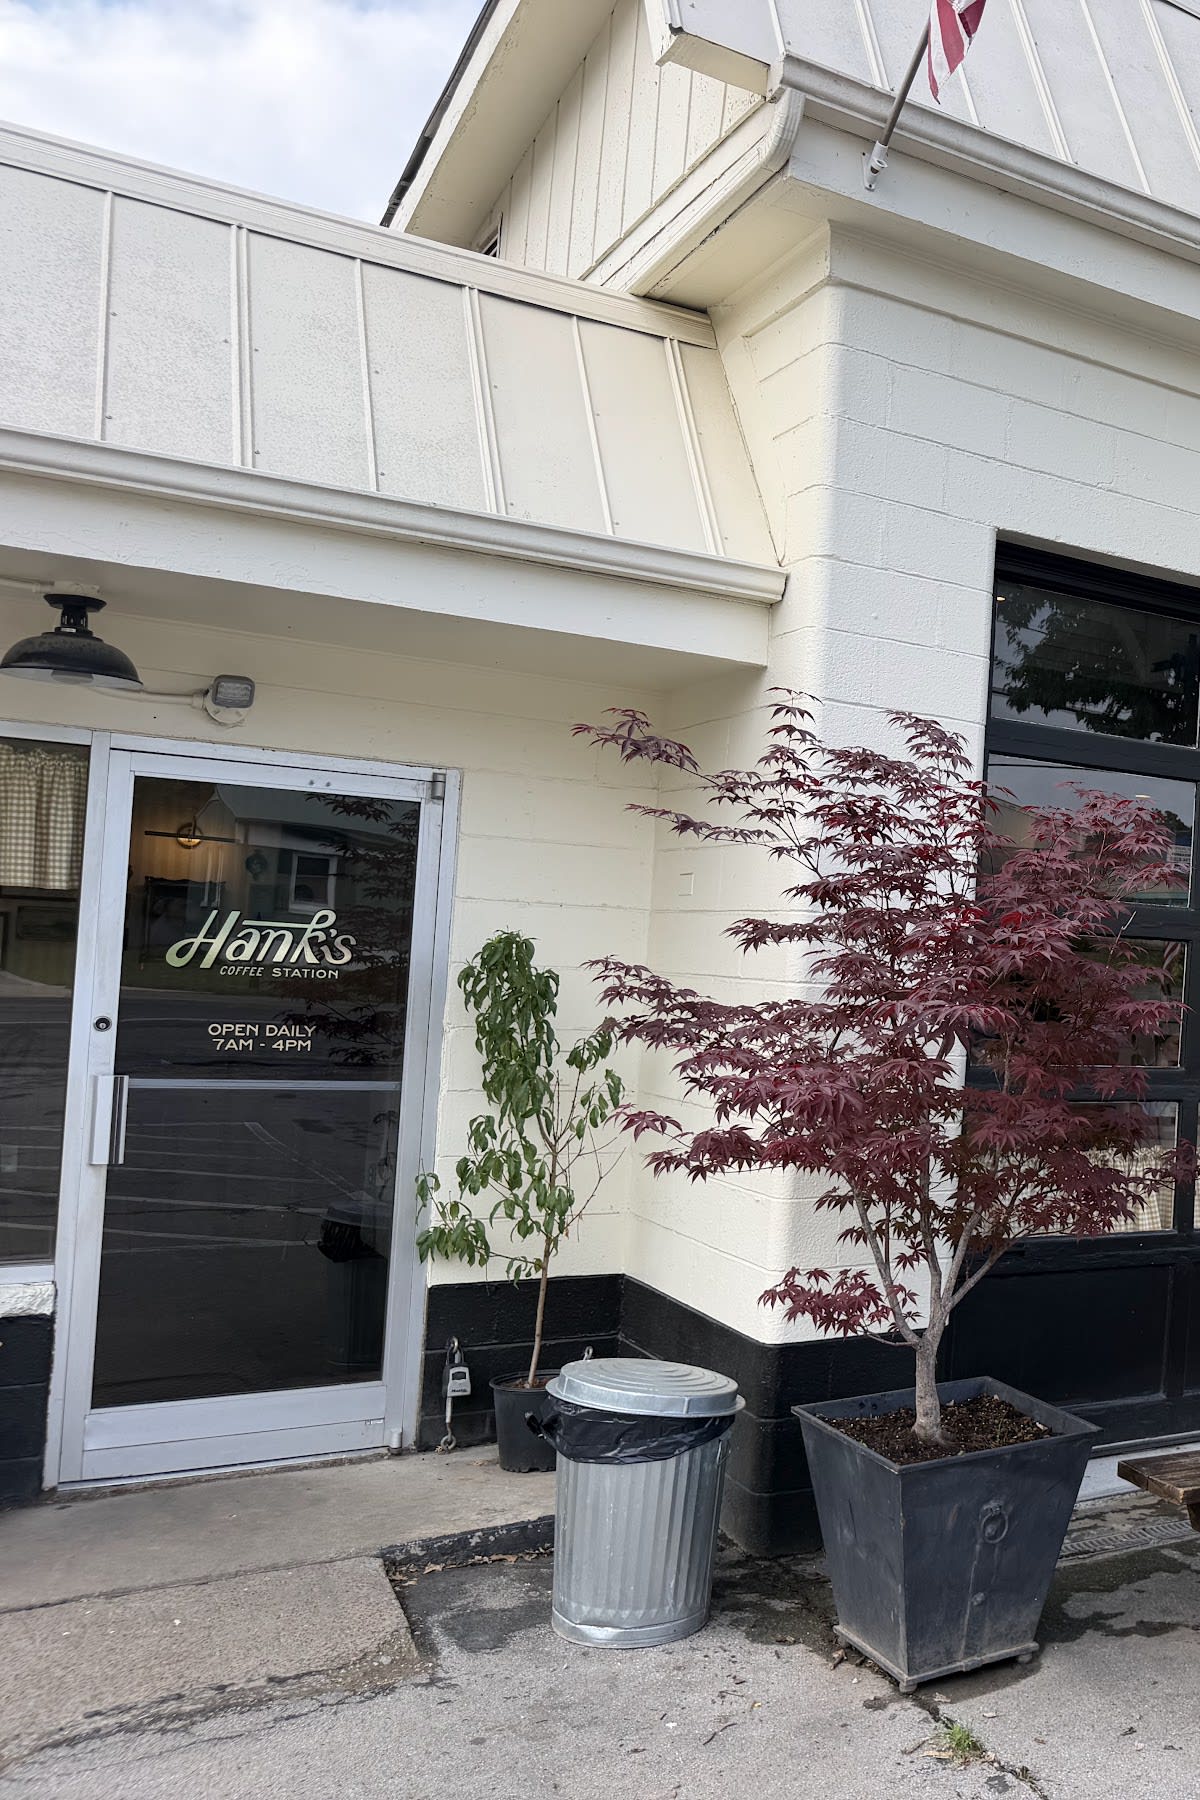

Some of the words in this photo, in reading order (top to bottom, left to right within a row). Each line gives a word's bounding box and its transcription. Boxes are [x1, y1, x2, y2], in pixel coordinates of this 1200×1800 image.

[165, 909, 357, 968] Hank's
[219, 965, 264, 977] COFFEE
[271, 967, 339, 979] STATION
[208, 1023, 259, 1036] OPEN
[265, 1024, 317, 1037] DAILY
[212, 1038, 253, 1051] 7AM
[271, 1039, 311, 1052] 4PM
